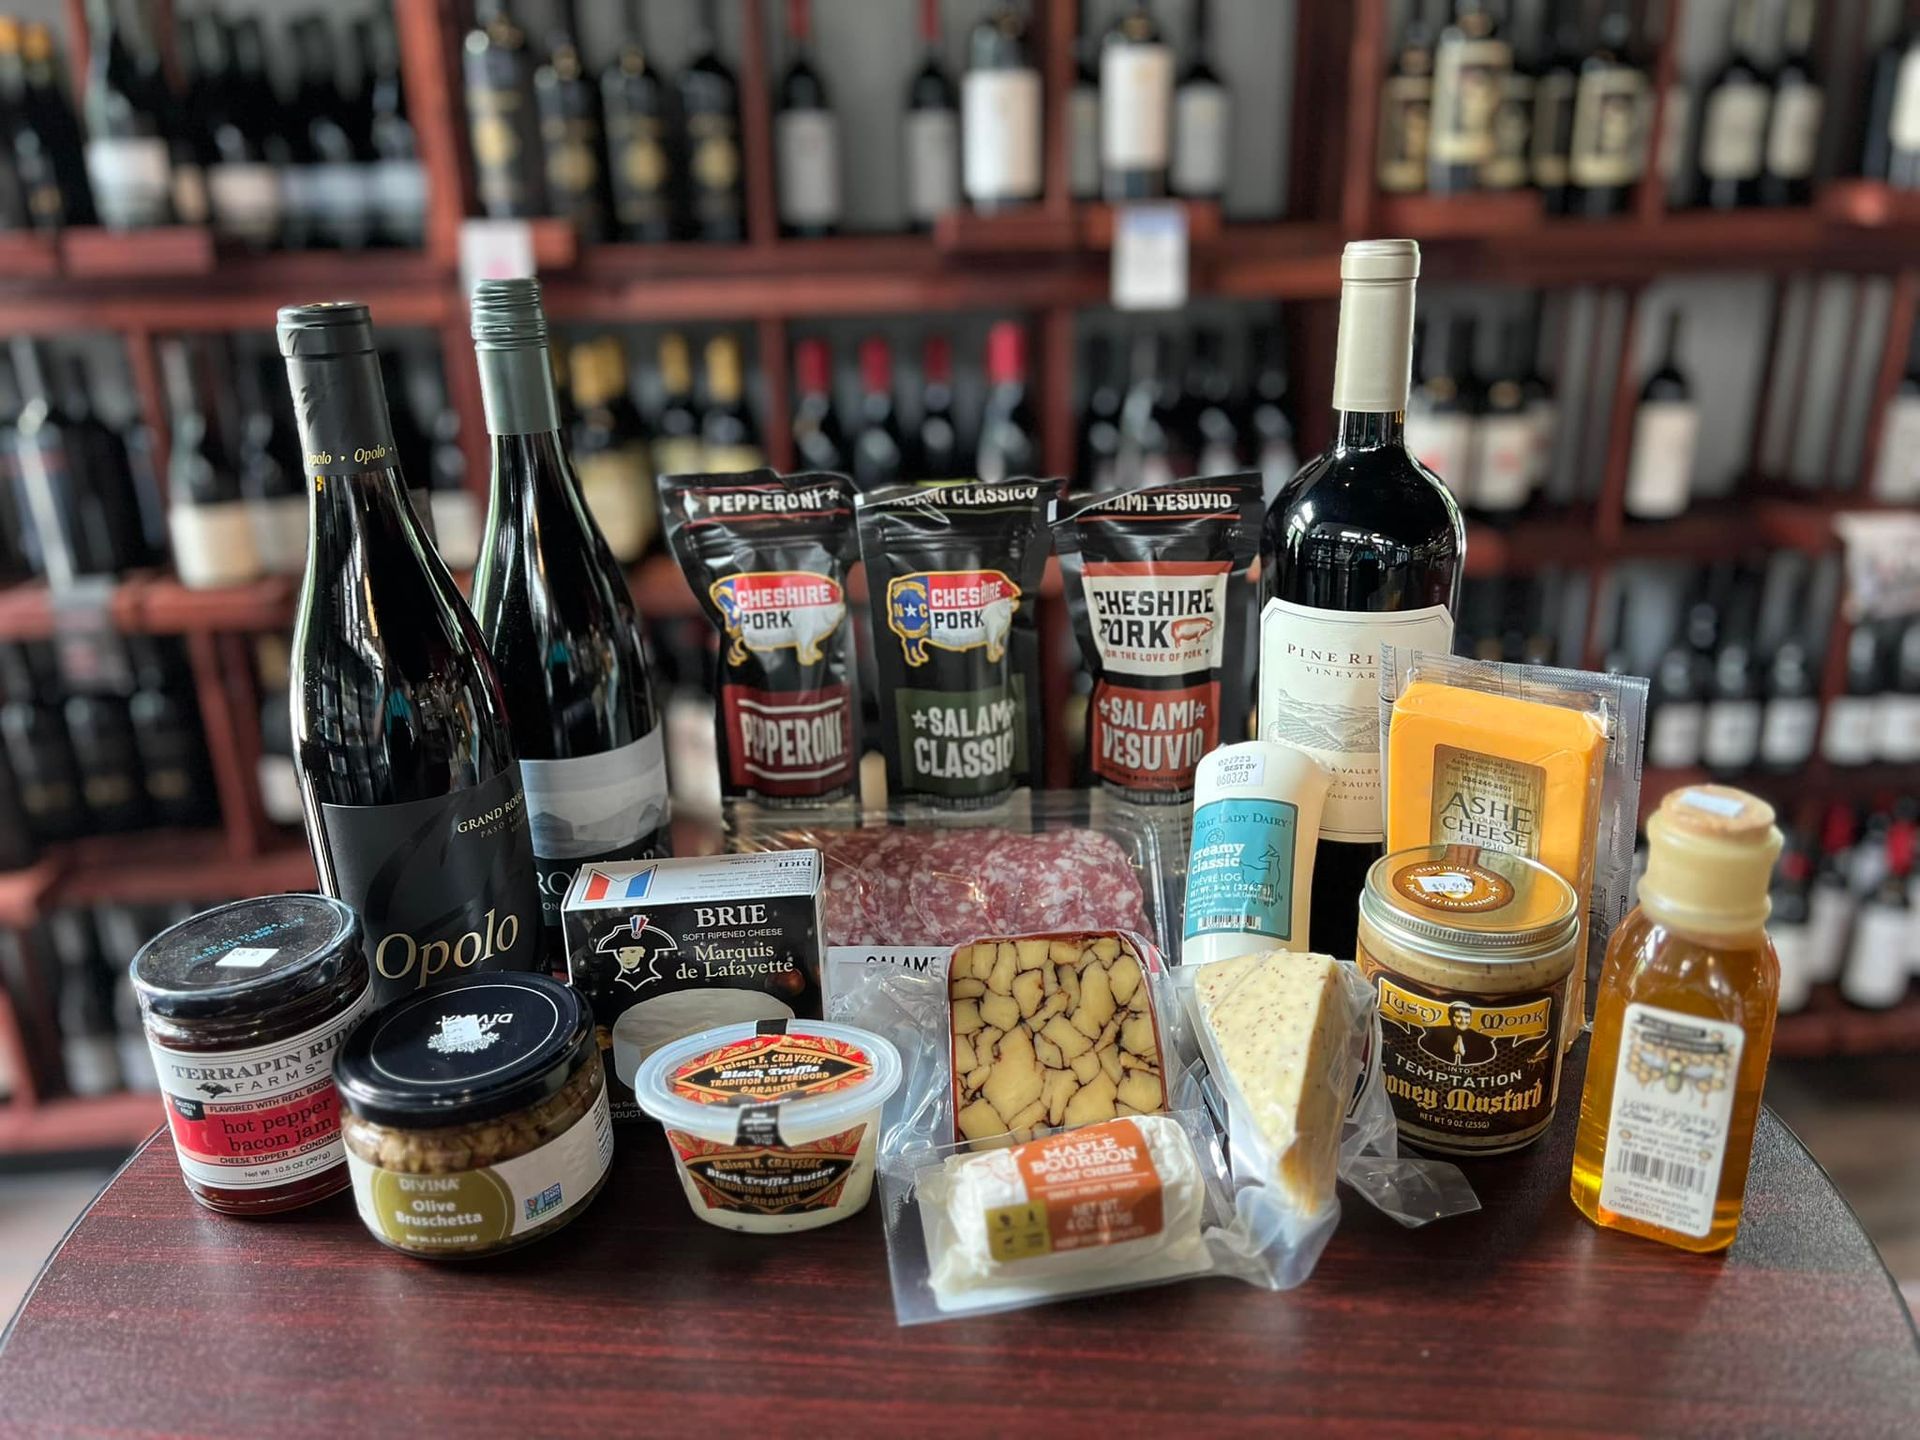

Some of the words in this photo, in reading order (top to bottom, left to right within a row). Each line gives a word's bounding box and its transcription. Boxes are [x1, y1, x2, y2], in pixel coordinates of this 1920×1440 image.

[354, 444, 386, 465] Opolo
[708, 489, 822, 514] PEPPERONI
[1153, 493, 1232, 511] VESUVIO
[736, 584, 832, 610] CHESHIRE
[1093, 588, 1214, 617] CHESHIRE
[934, 609, 985, 630] PORK
[1100, 618, 1170, 649] PORK
[1120, 651, 1137, 661] THE
[1140, 652, 1167, 663] LOVE
[1169, 652, 1181, 662] OF
[1287, 643, 1338, 664] PINE
[1306, 666, 1376, 679] VINEYAR
[1110, 697, 1195, 731] SALAMI
[1101, 722, 1204, 771] VESUVIO
[457, 807, 503, 833] GRAND
[1254, 812, 1288, 828] DAIRY
[1440, 791, 1532, 836] ASHE
[1442, 815, 1527, 849] CHEESE
[694, 904, 768, 928] BRIE
[682, 932, 706, 942] SOFT
[707, 929, 746, 941] RIPENED
[747, 927, 783, 937] CHEESE
[376, 907, 519, 991] Opolo
[693, 942, 775, 962] Marquis
[675, 962, 699, 980] de
[703, 959, 794, 979] Lafayette
[172, 1050, 302, 1081] TERRAPIN
[714, 1058, 756, 1073] Maison
[757, 1055, 768, 1065] F.
[772, 1053, 826, 1065] CRAYSSAC
[720, 1068, 764, 1079] Black
[768, 1064, 820, 1076] Truffle
[1395, 1052, 1522, 1089] TEMPTATION
[1448, 1065, 1471, 1074] INTO
[710, 1077, 761, 1088] TRADITION
[764, 1074, 778, 1084] DU
[209, 1103, 254, 1113] FLAVORED
[256, 1097, 280, 1109] WITH
[281, 1090, 305, 1103] REAL
[1384, 1073, 1438, 1110] oney
[1442, 1078, 1543, 1115] Mustard
[222, 1118, 256, 1135] hot
[261, 1098, 331, 1134] pepper
[1447, 1118, 1453, 1126] 9
[228, 1134, 290, 1155] bacon
[294, 1117, 333, 1143] jam
[220, 1154, 250, 1165] CHEESE
[253, 1150, 289, 1163] TOPPER
[1042, 1136, 1118, 1161] MAPLE
[1029, 1145, 1138, 1176] BOURBON
[399, 1178, 460, 1192] DIVINA
[706, 1166, 742, 1185] Black
[744, 1175, 790, 1187] Truffle
[792, 1166, 836, 1184] Butter
[411, 1199, 457, 1213] Olive
[395, 1210, 483, 1226] Bruschetta
